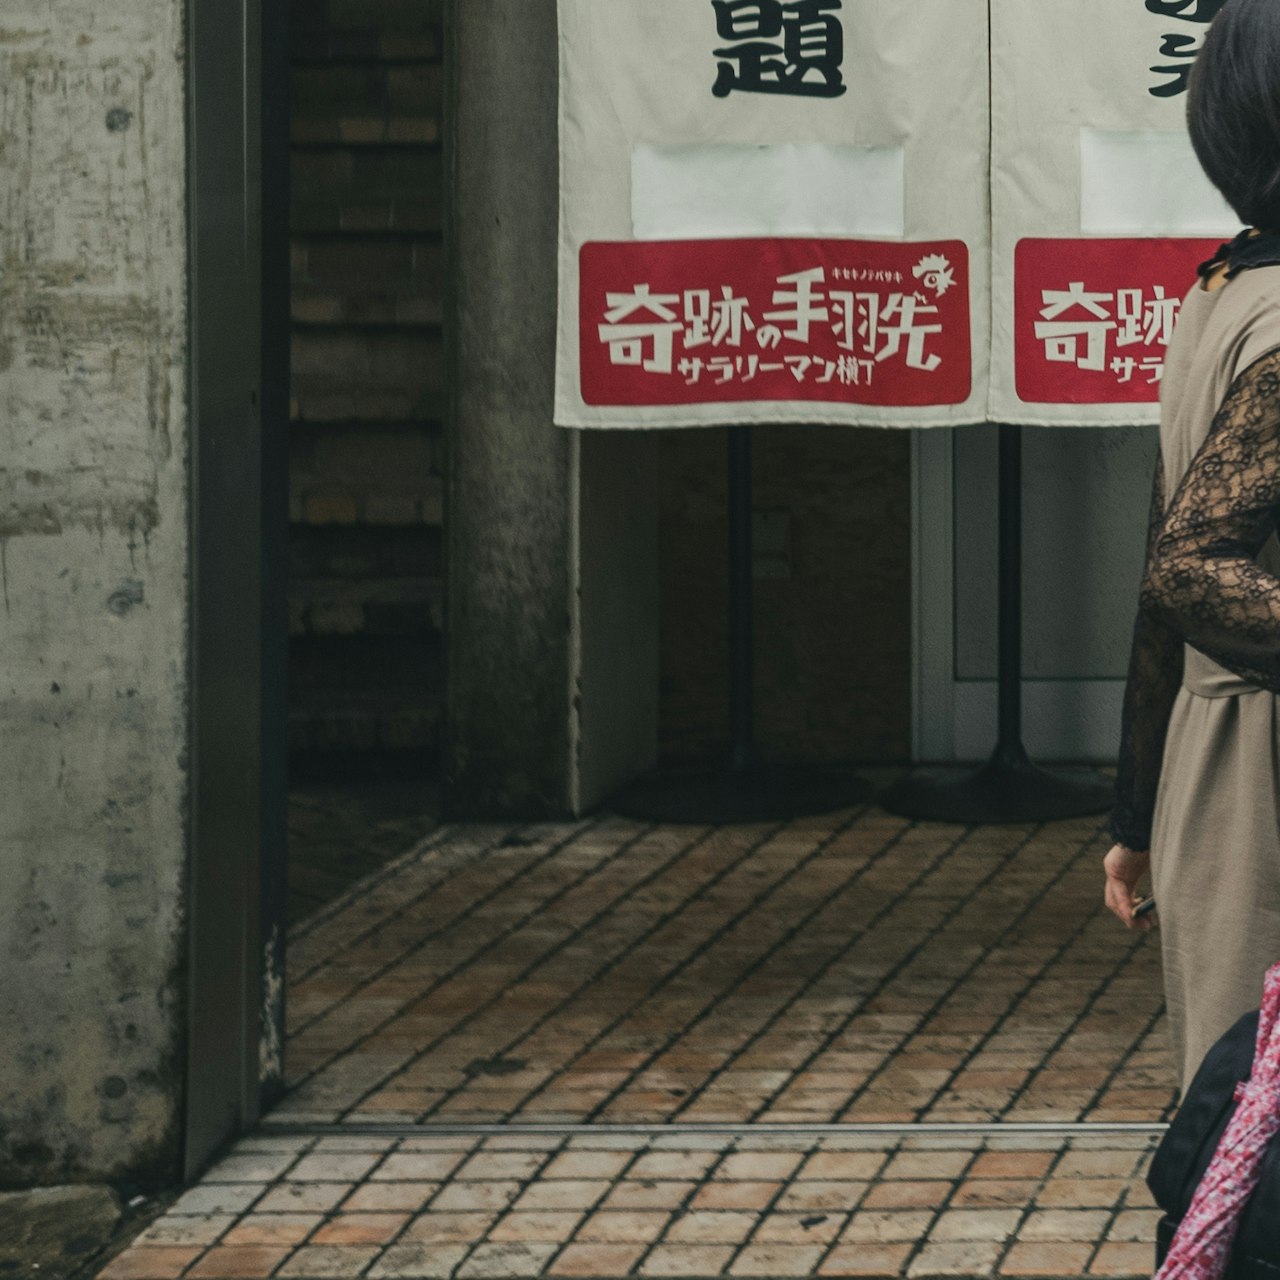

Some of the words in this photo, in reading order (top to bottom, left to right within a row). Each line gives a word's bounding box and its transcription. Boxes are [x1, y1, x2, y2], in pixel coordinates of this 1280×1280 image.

[832, 267, 904, 284] キセキノテバサキ
[598, 265, 944, 375] 奇跡の手羽先
[677, 354, 876, 386] サラリーマン横丁
